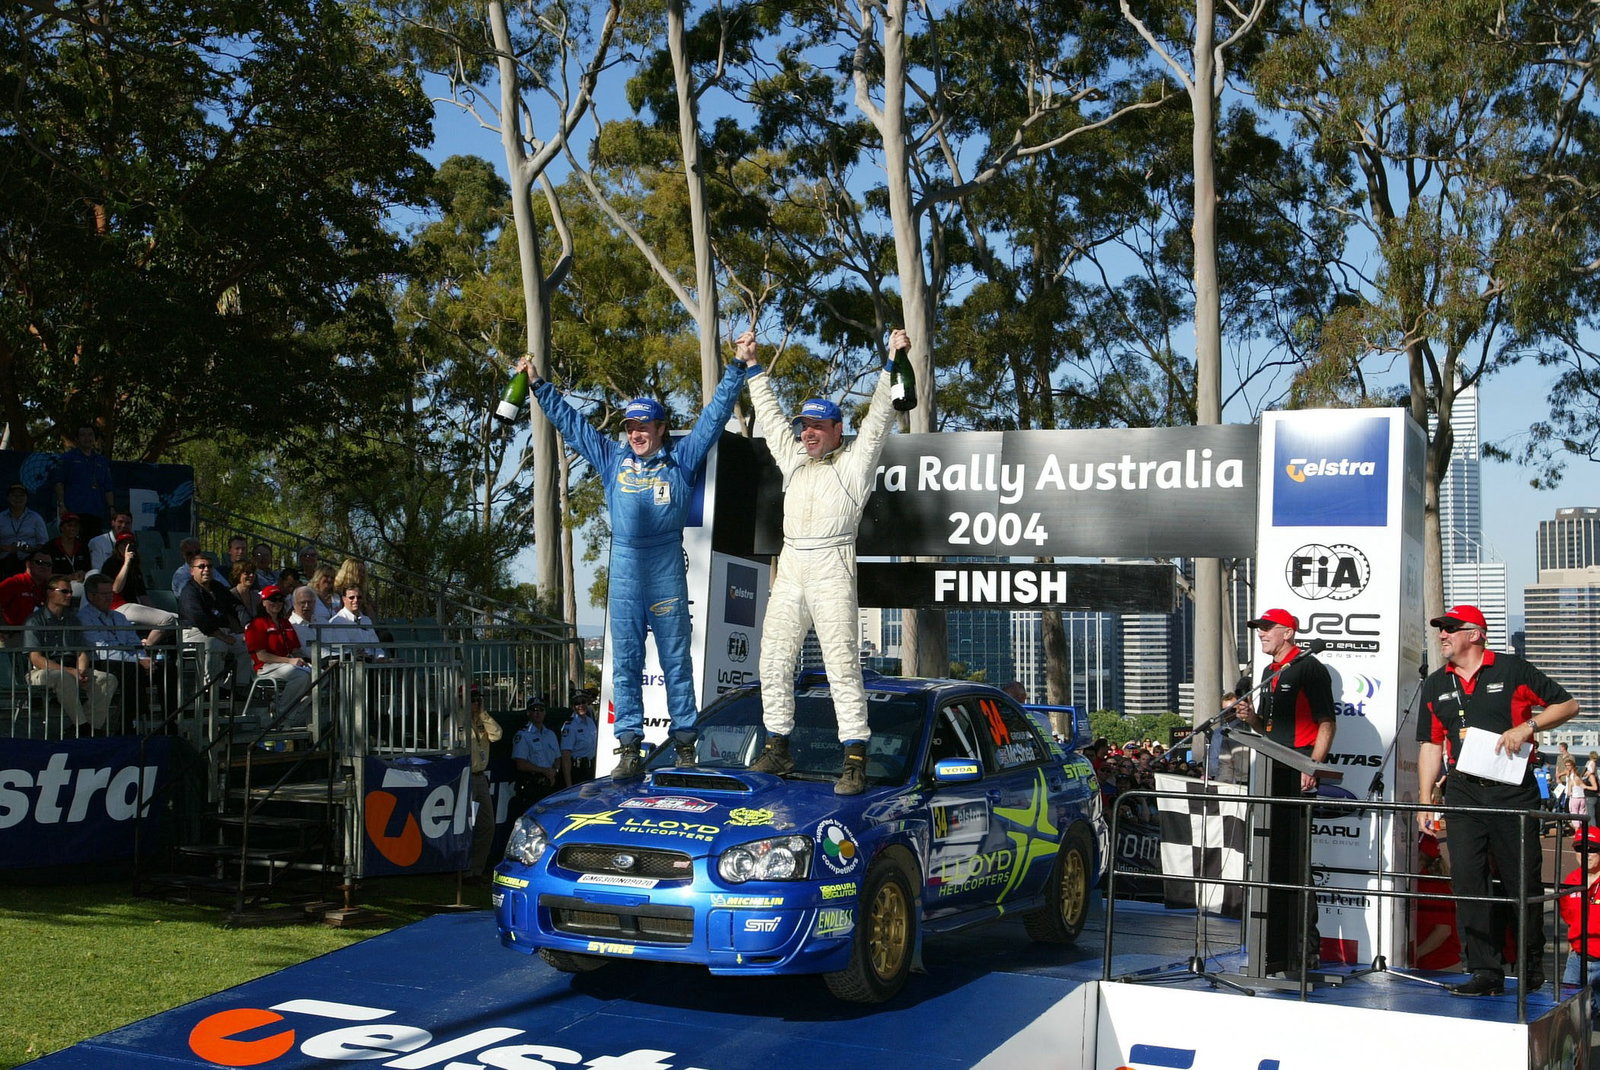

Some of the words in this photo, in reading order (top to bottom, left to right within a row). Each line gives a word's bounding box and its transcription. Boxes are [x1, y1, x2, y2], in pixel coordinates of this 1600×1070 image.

[918, 454, 1025, 504] Rally
[1035, 448, 1244, 491] Australia
[1286, 458, 1375, 482] Telstra
[658, 485, 665, 497] 4
[948, 512, 1049, 546] 2004
[935, 570, 1067, 603] FINISH
[1337, 642, 1377, 650] RALLY
[945, 766, 973, 774] YODA
[625, 818, 720, 834] LLOYD
[935, 806, 948, 838] 34
[619, 826, 714, 842] HELICOPTERS
[941, 850, 1012, 882] LLOYD
[938, 871, 1011, 897] HELICOPTERS
[726, 896, 784, 906] MICHELIN
[1331, 894, 1371, 907] Perth
[818, 908, 853, 930] ENDLESS
